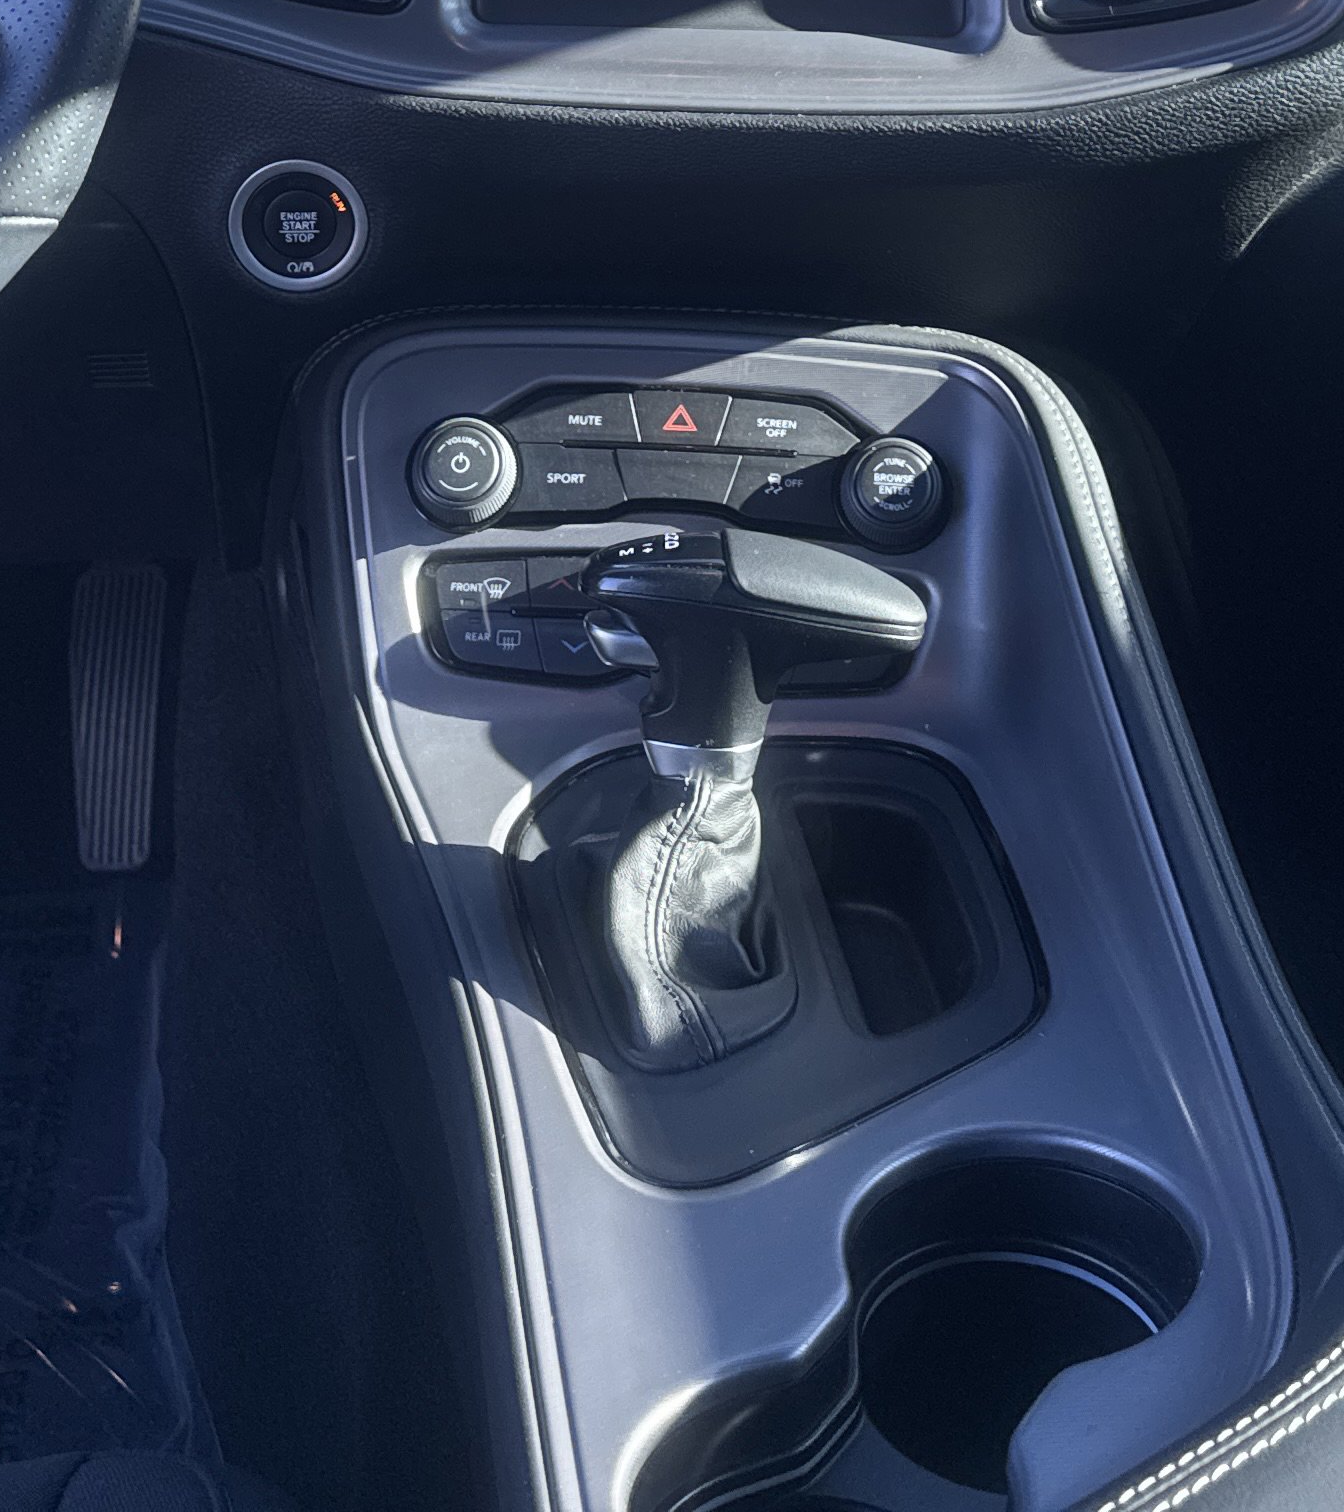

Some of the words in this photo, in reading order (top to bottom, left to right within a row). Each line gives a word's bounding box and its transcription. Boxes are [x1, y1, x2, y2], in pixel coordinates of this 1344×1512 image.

[279, 211, 318, 221] ENGINE
[281, 221, 317, 231] START
[284, 233, 316, 243] STOP
[567, 413, 603, 427] MUTE
[756, 417, 798, 430] SCREEN
[765, 427, 787, 439] OFF
[445, 435, 481, 448] VOLUME
[883, 457, 906, 468] TUNE
[545, 472, 586, 486] SPORT
[784, 477, 804, 489] OFF
[873, 472, 916, 483] BROWSE
[878, 485, 911, 496] ENTER
[664, 541, 680, 550] D
[618, 548, 635, 557] M
[449, 580, 483, 593] FRONT
[464, 631, 491, 644] REAR
